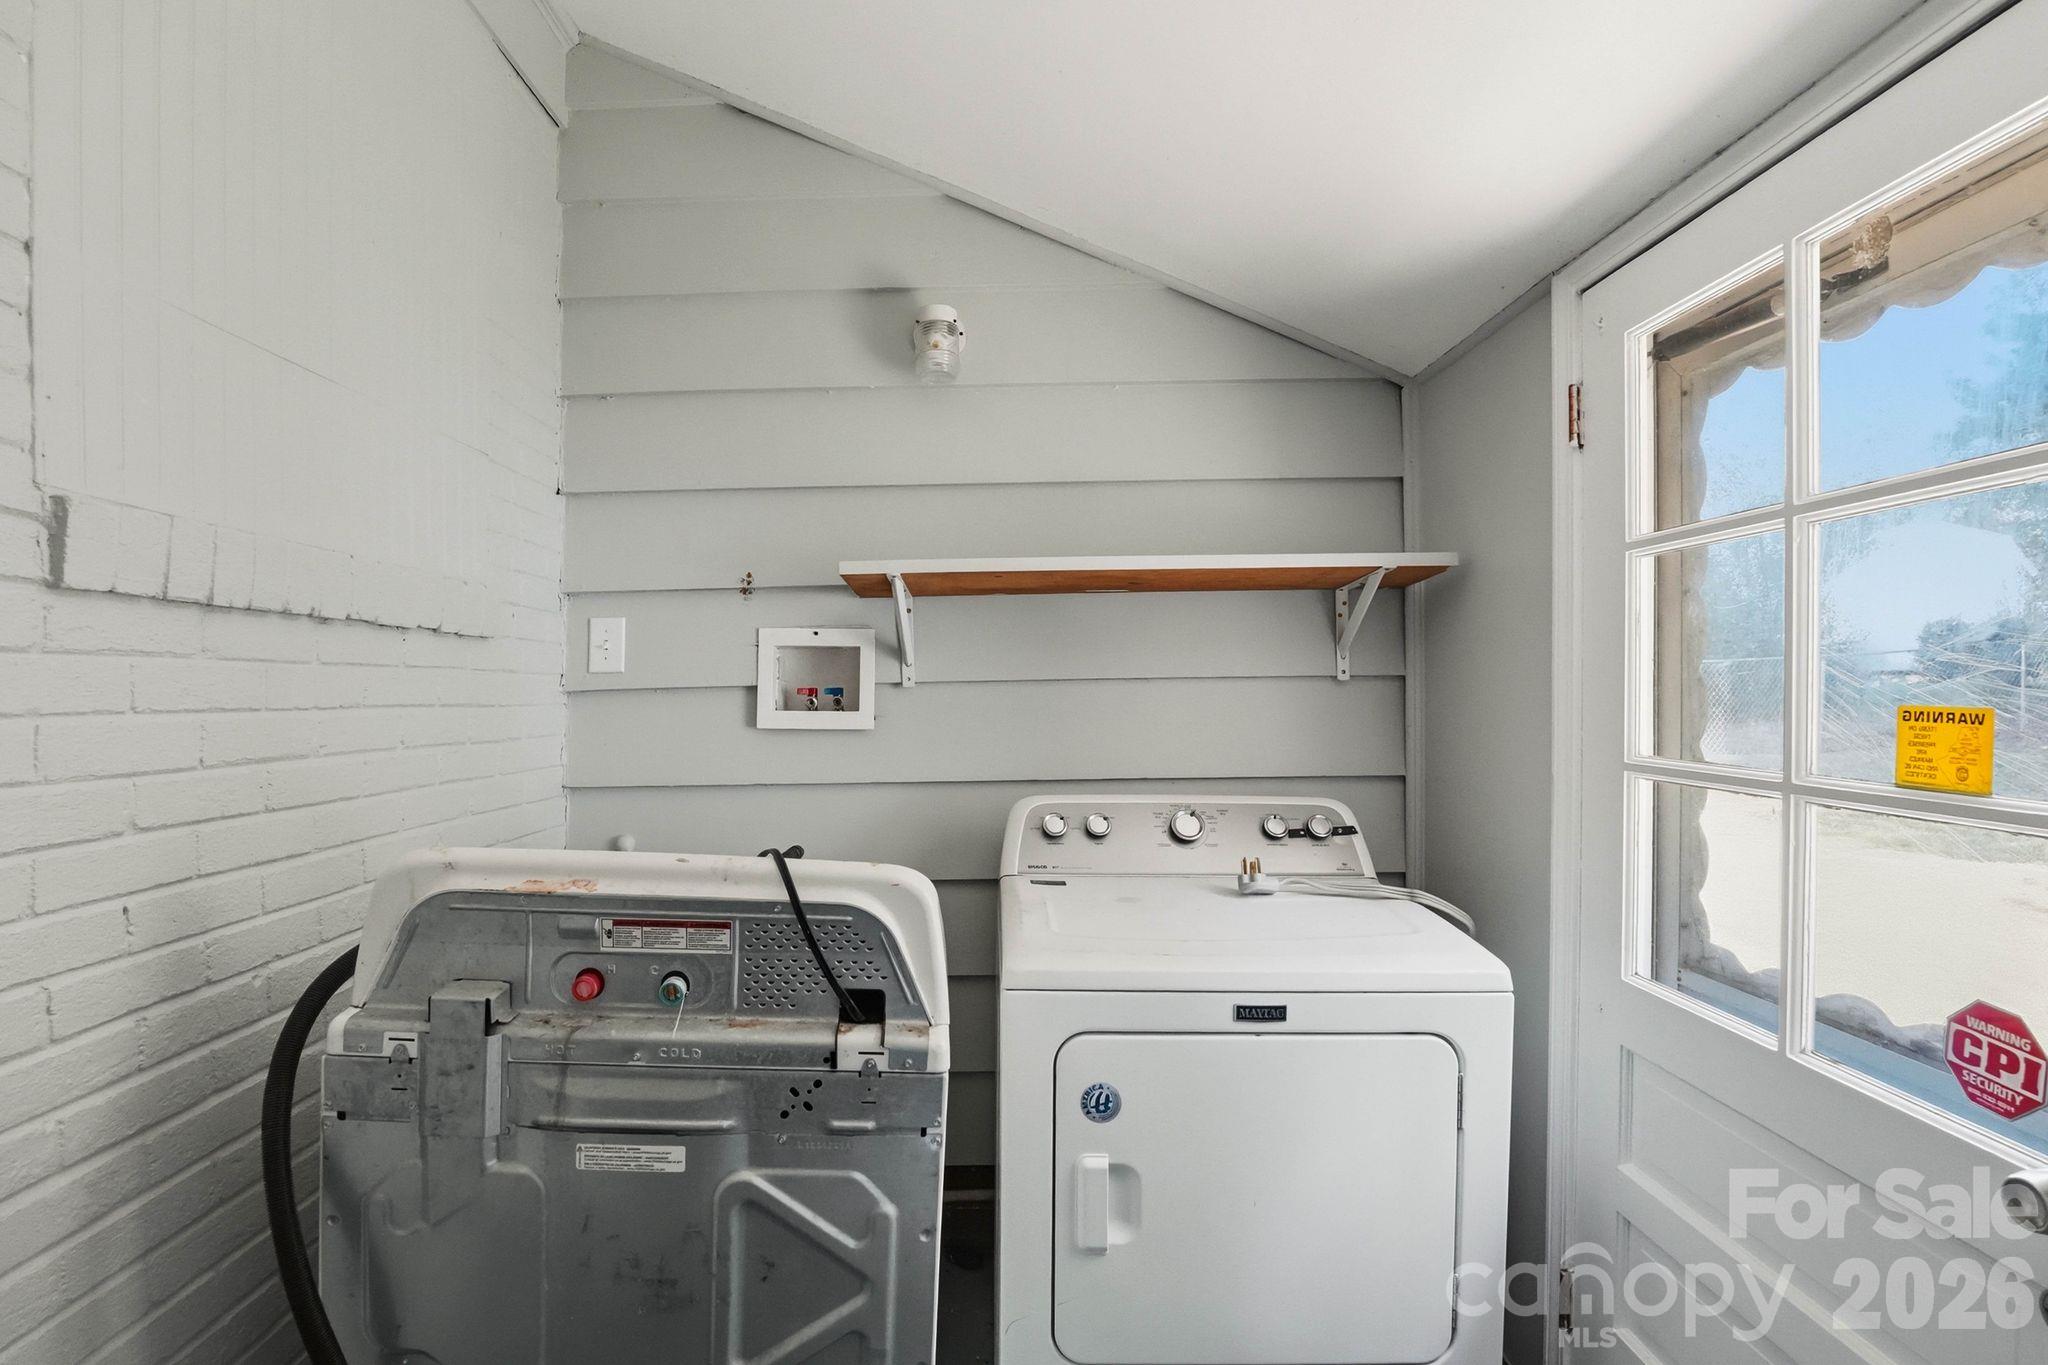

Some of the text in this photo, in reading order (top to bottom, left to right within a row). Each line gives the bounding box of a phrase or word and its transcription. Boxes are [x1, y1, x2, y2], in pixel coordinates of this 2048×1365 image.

[1239, 1007, 1284, 1019] MAYTAG
[1966, 1015, 2031, 1052] WARNING
[659, 1047, 702, 1058] COLD
[1951, 1027, 2043, 1098] CPI
[1962, 1070, 2023, 1105] SECURITY
